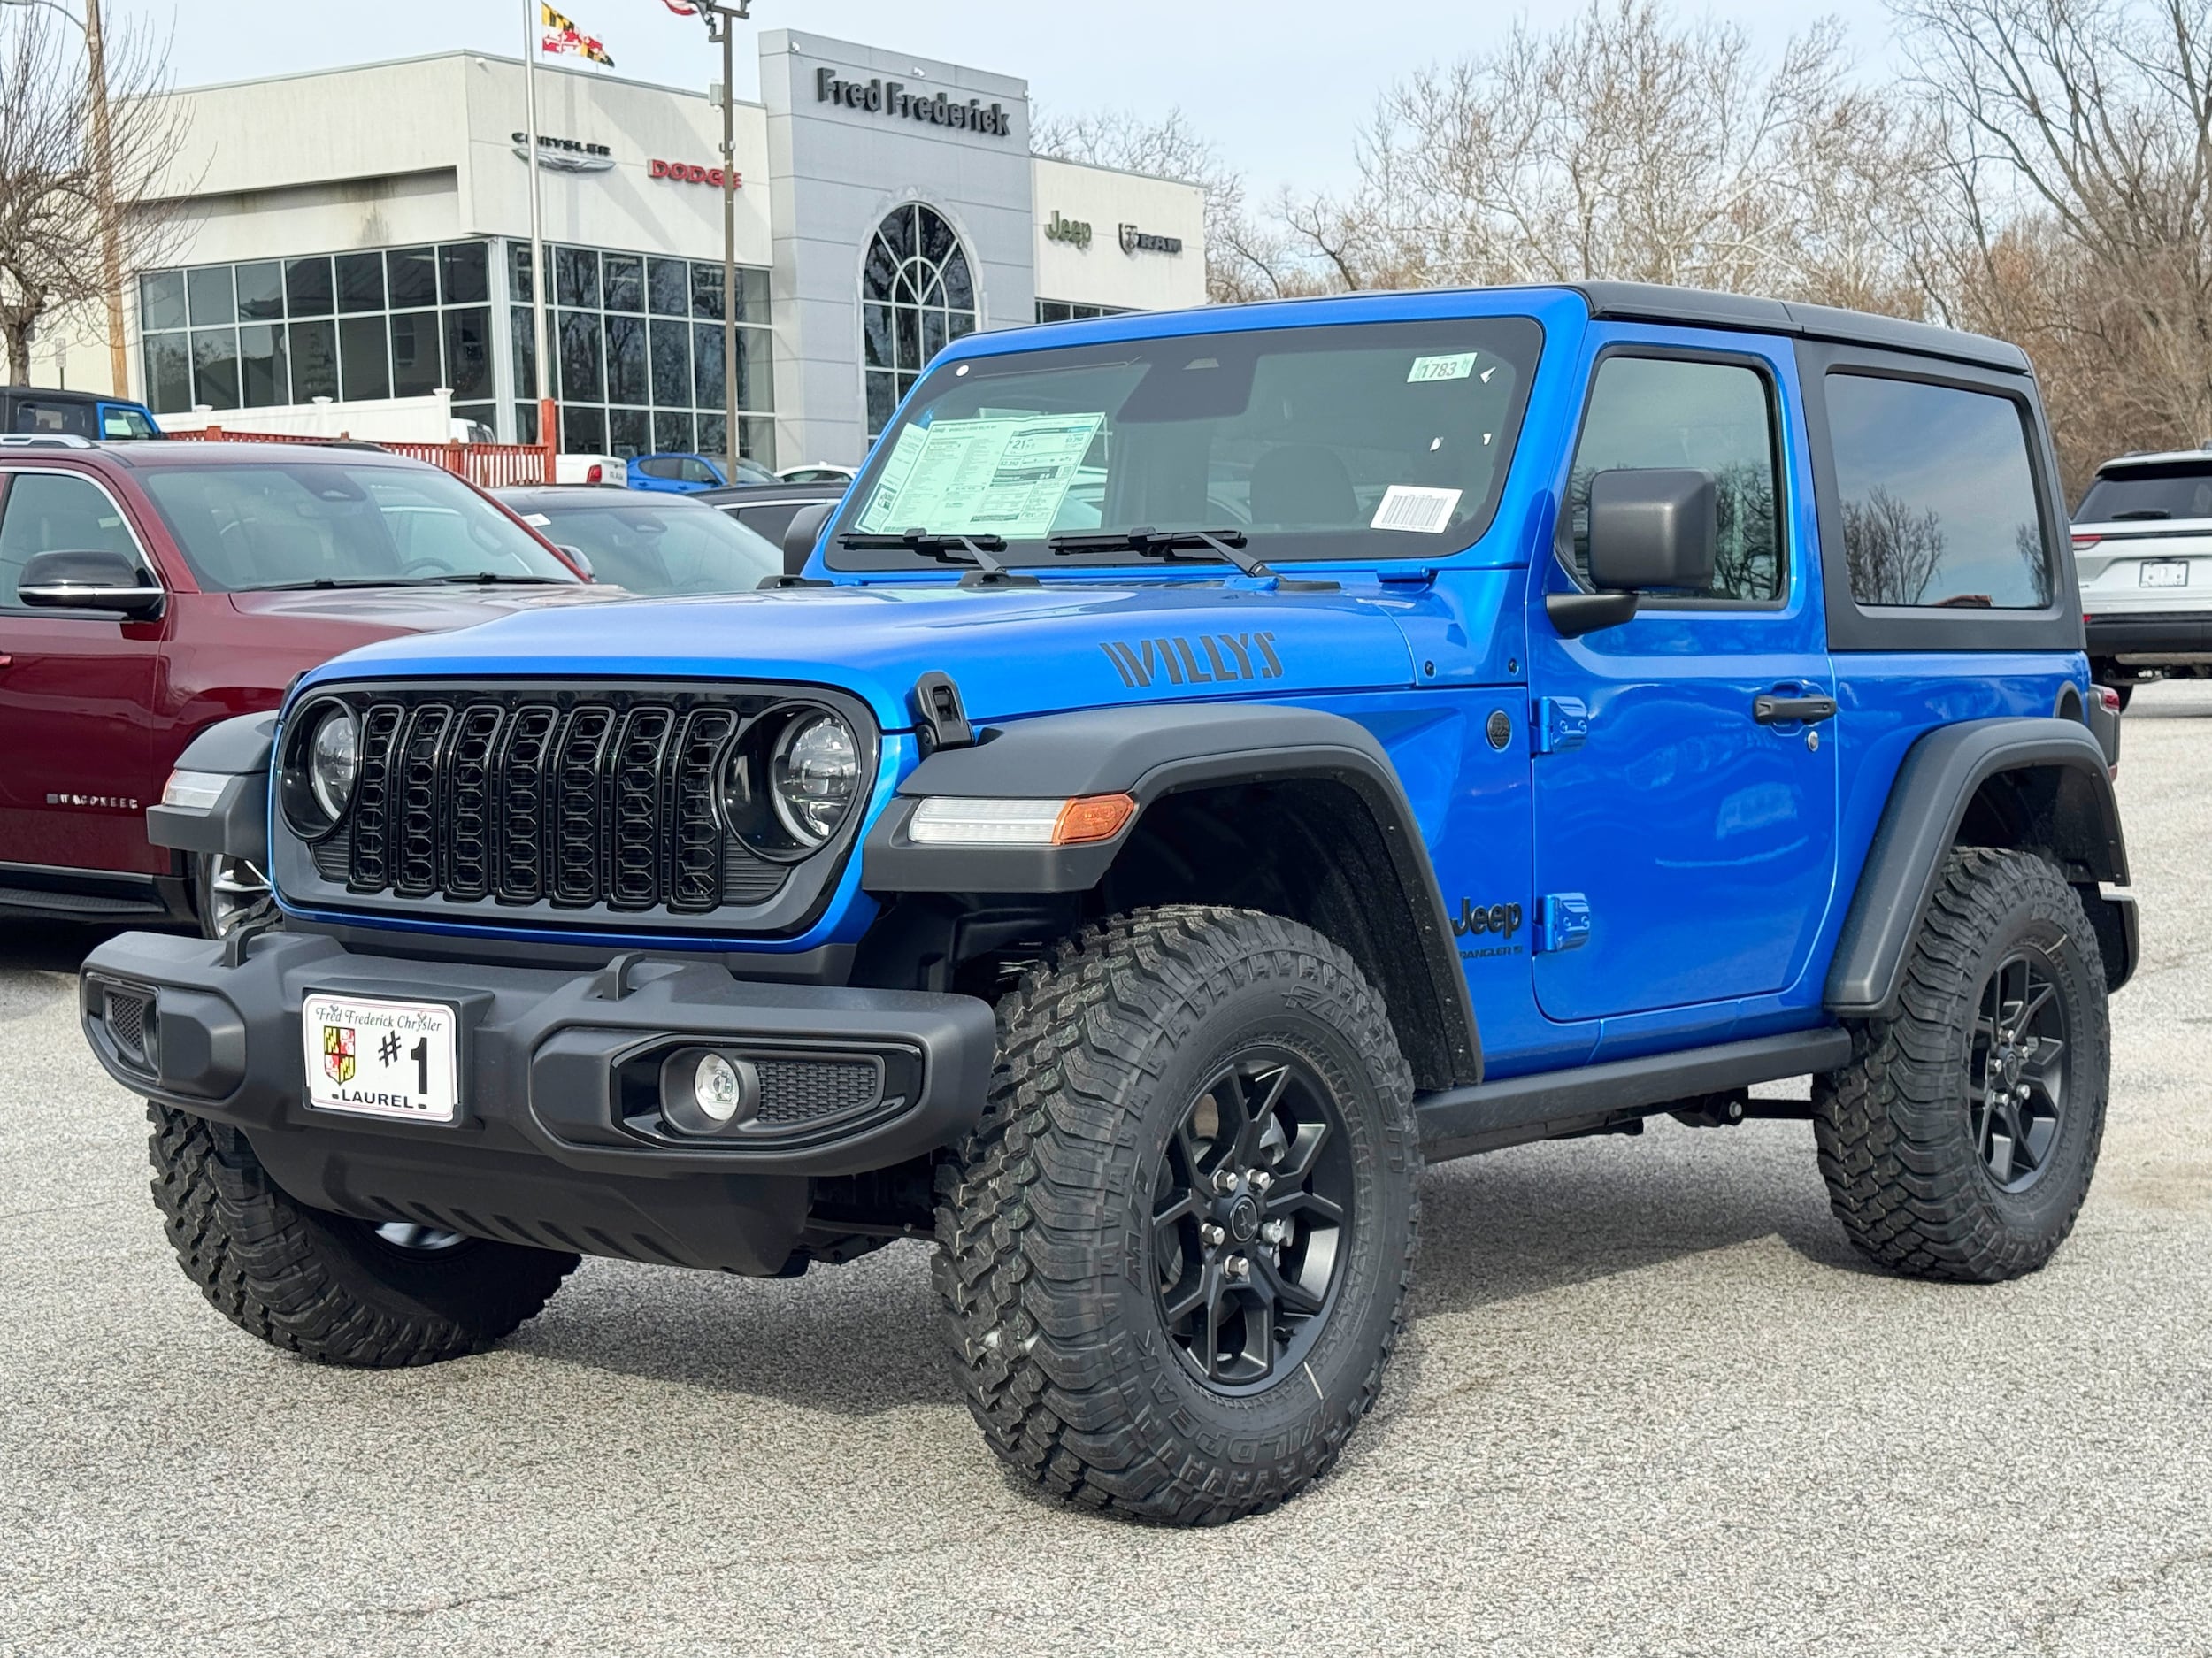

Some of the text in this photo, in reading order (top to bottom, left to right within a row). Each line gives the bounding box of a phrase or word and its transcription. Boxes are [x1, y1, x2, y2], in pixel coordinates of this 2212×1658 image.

[817, 67, 1011, 136] Fred Frederick
[1044, 210, 1093, 249] Jeep
[1137, 233, 1182, 254] RAM
[1421, 361, 1458, 379] 1783
[1098, 632, 1283, 687] WILLYS
[1450, 896, 1522, 940] Jeep
[1458, 946, 1512, 960] RANGLER
[315, 1006, 442, 1032] Fred Frederick Chrysler
